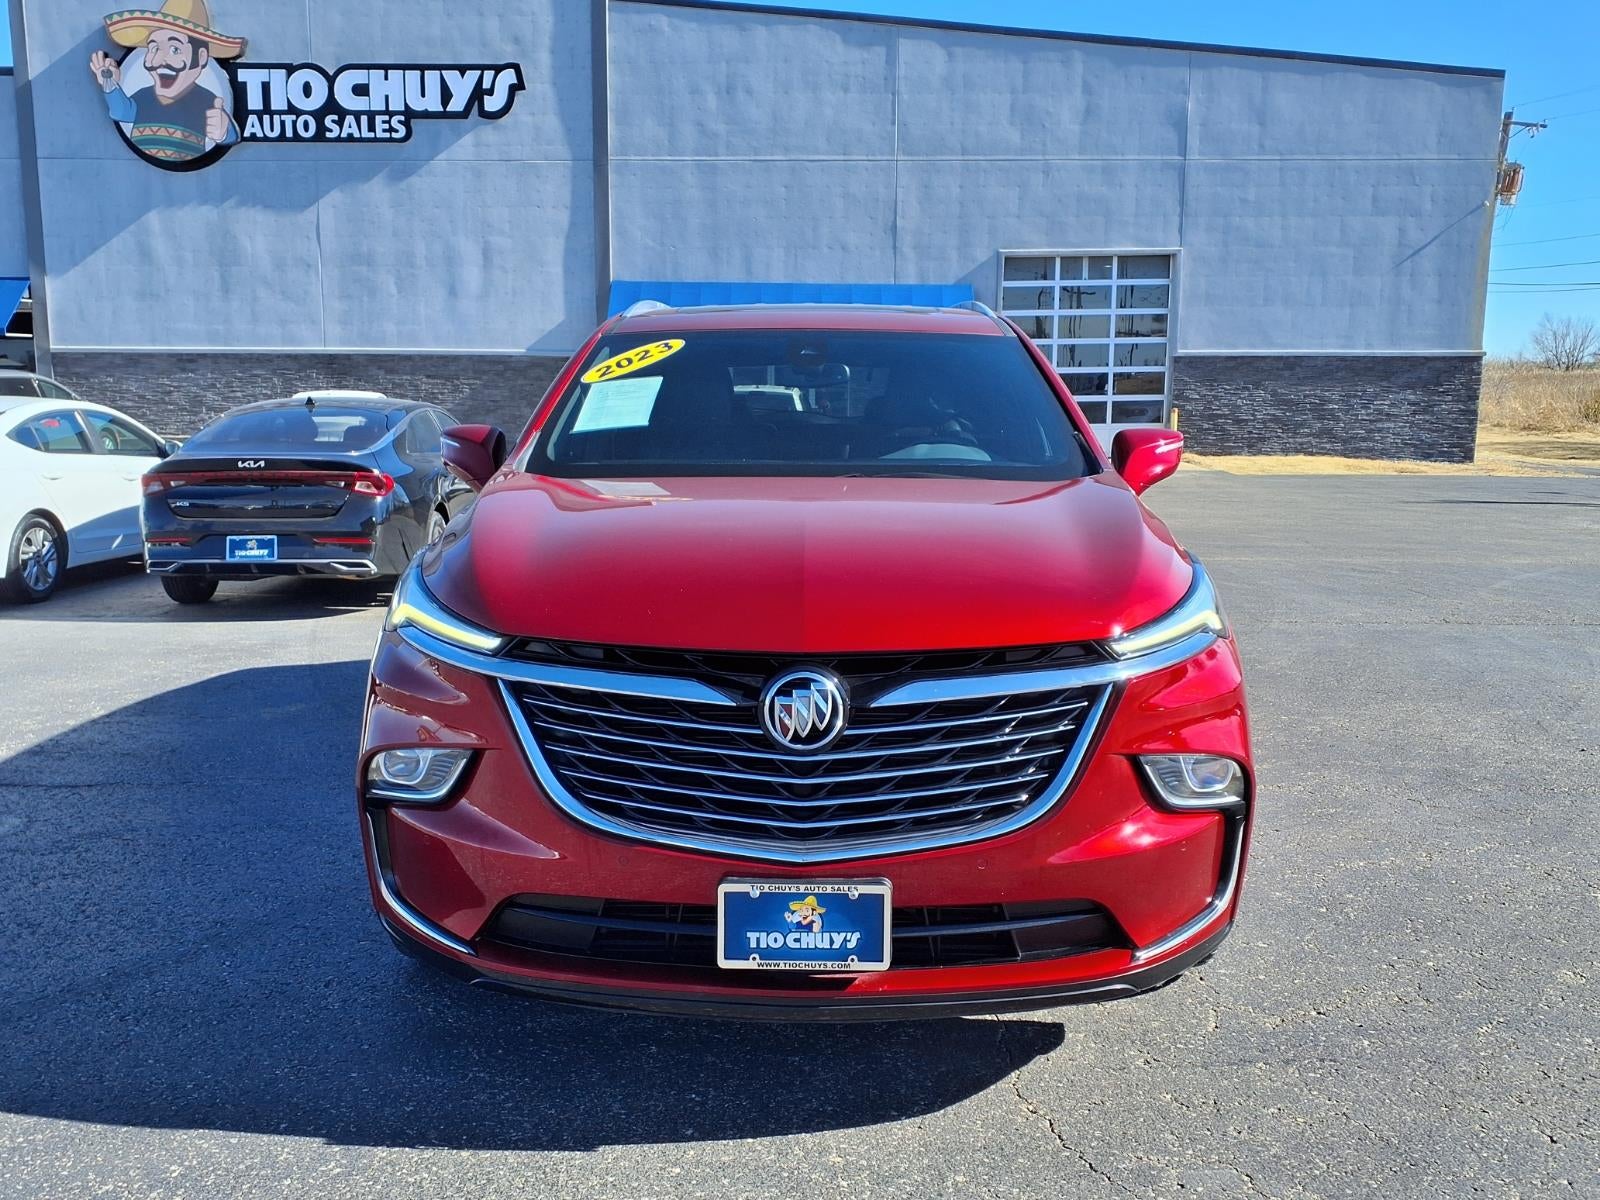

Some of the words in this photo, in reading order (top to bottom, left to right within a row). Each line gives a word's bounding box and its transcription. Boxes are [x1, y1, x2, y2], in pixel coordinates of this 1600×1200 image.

[237, 69, 328, 111] TIO
[334, 69, 519, 112] CHUY'S
[244, 114, 316, 138] AUTO
[325, 114, 407, 138] SALES
[596, 342, 674, 378] 2023
[747, 931, 784, 949] TIO
[785, 931, 861, 949] CHUY'S
[757, 961, 851, 969] WWW.TIOCHUYS.COM
